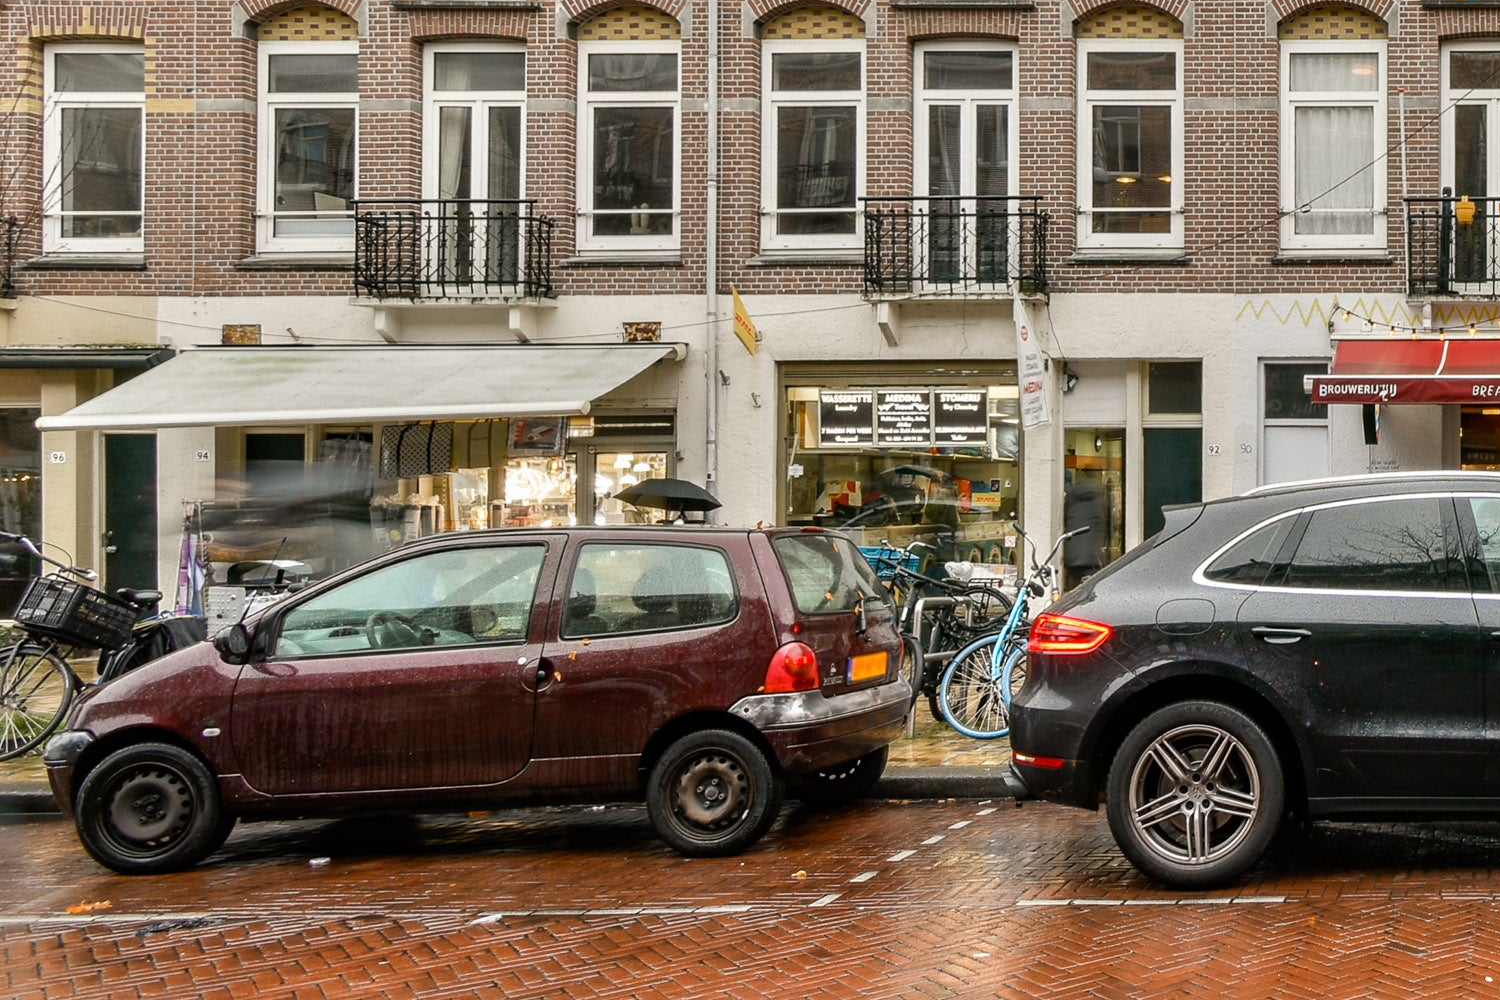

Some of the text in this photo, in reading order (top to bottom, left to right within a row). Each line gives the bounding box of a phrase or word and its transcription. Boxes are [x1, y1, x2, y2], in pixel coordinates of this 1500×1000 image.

[1209, 445, 1220, 454] 92
[52, 453, 65, 462] 96
[197, 451, 208, 460] 94
